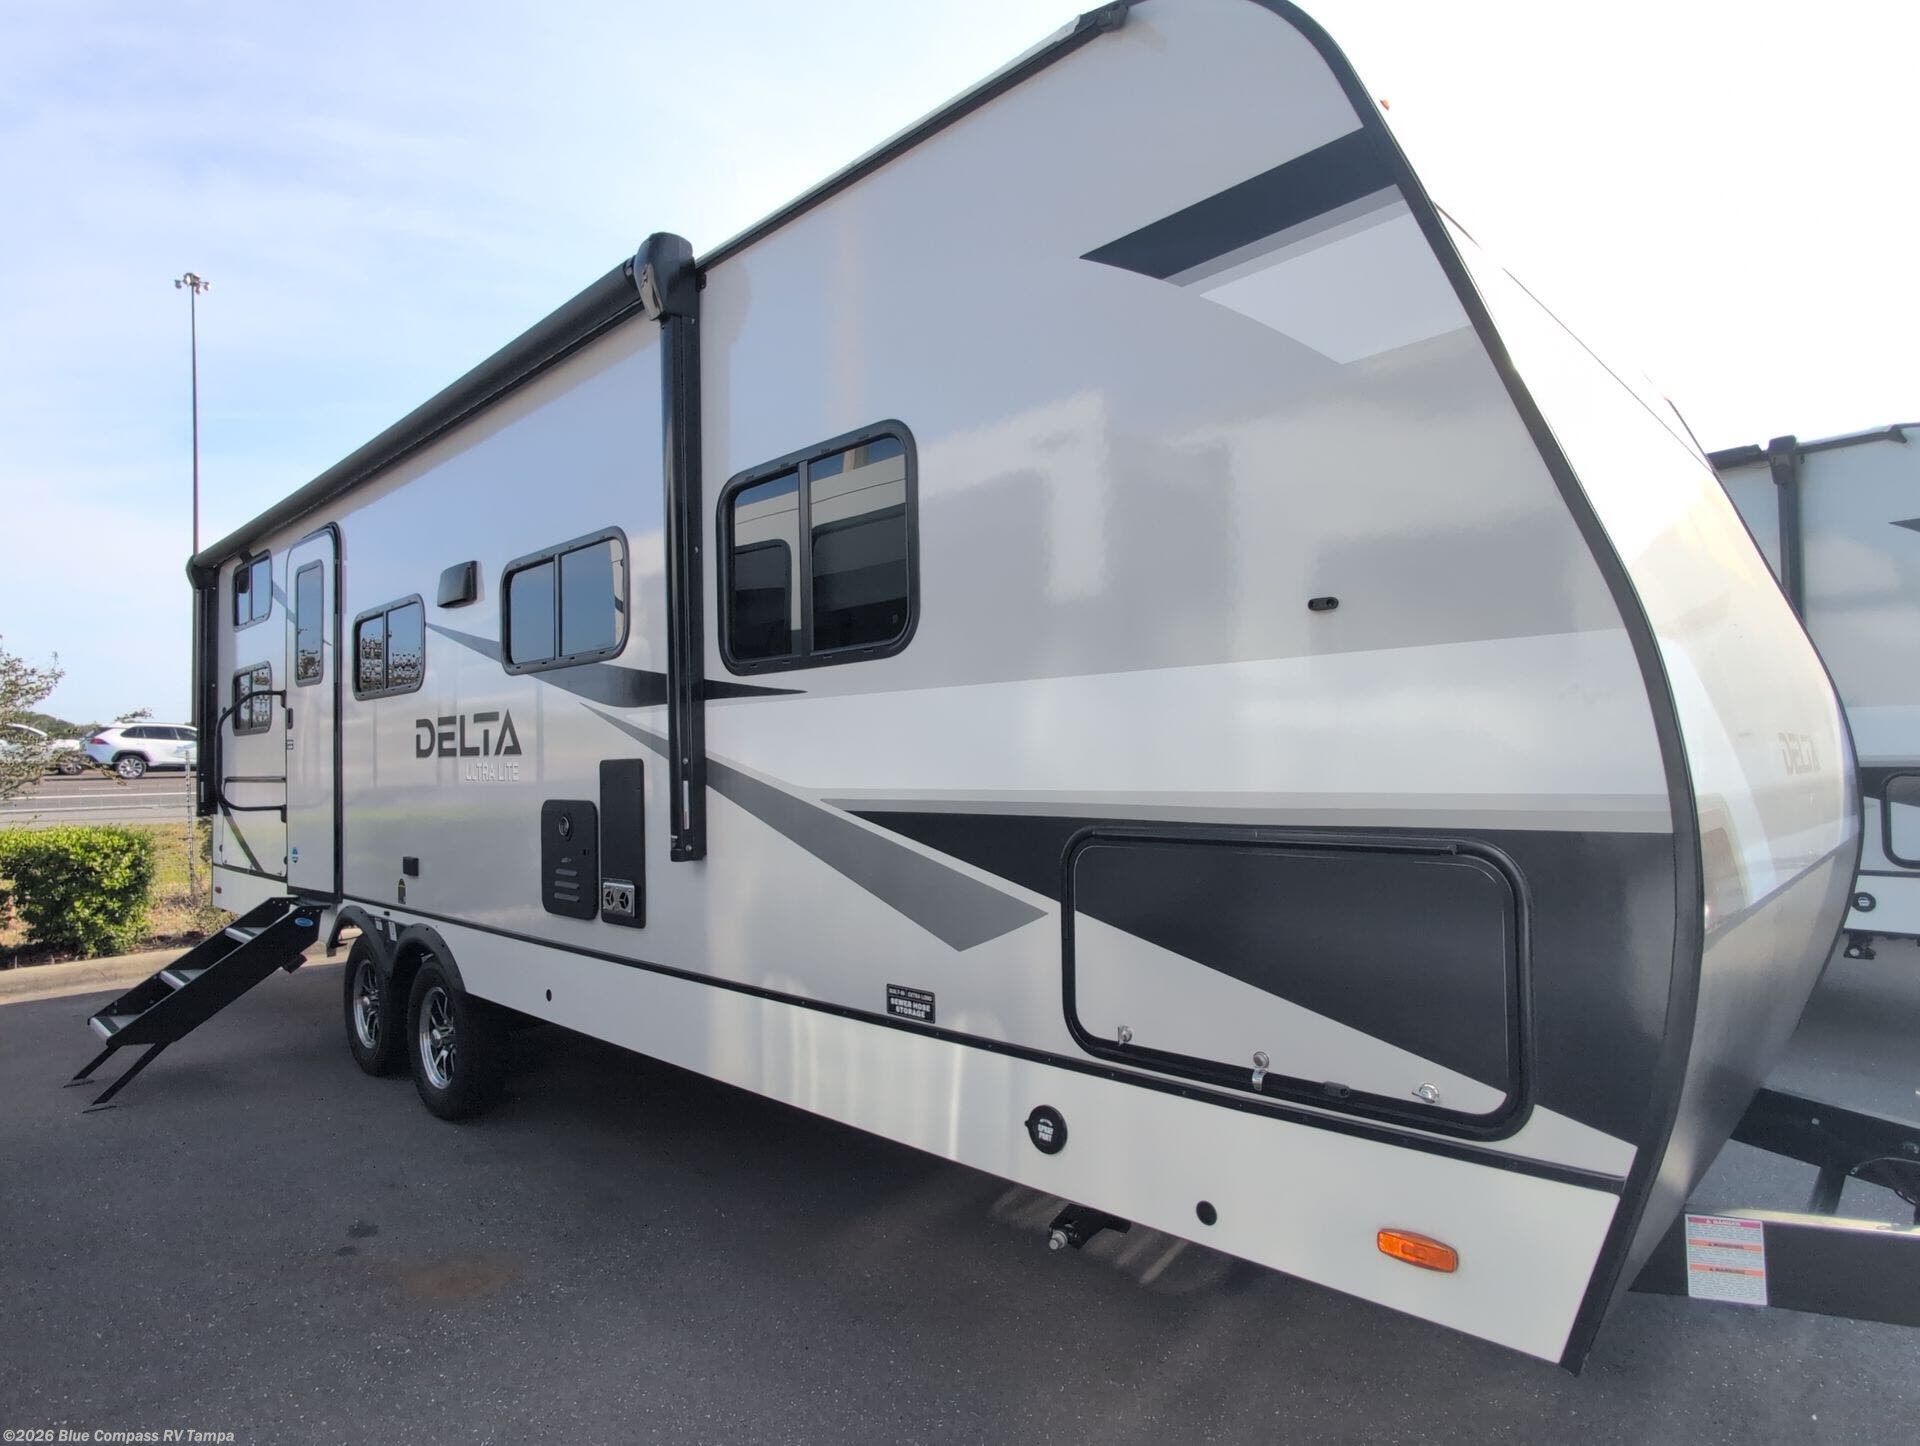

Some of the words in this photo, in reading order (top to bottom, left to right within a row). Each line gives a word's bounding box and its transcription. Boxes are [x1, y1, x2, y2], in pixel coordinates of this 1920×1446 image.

[416, 709, 522, 759] DELTA
[498, 760, 519, 782] LITE
[890, 998, 911, 1007] SEWER
[913, 1002, 930, 1012] HOSE
[895, 1006, 925, 1018] STORAGE
